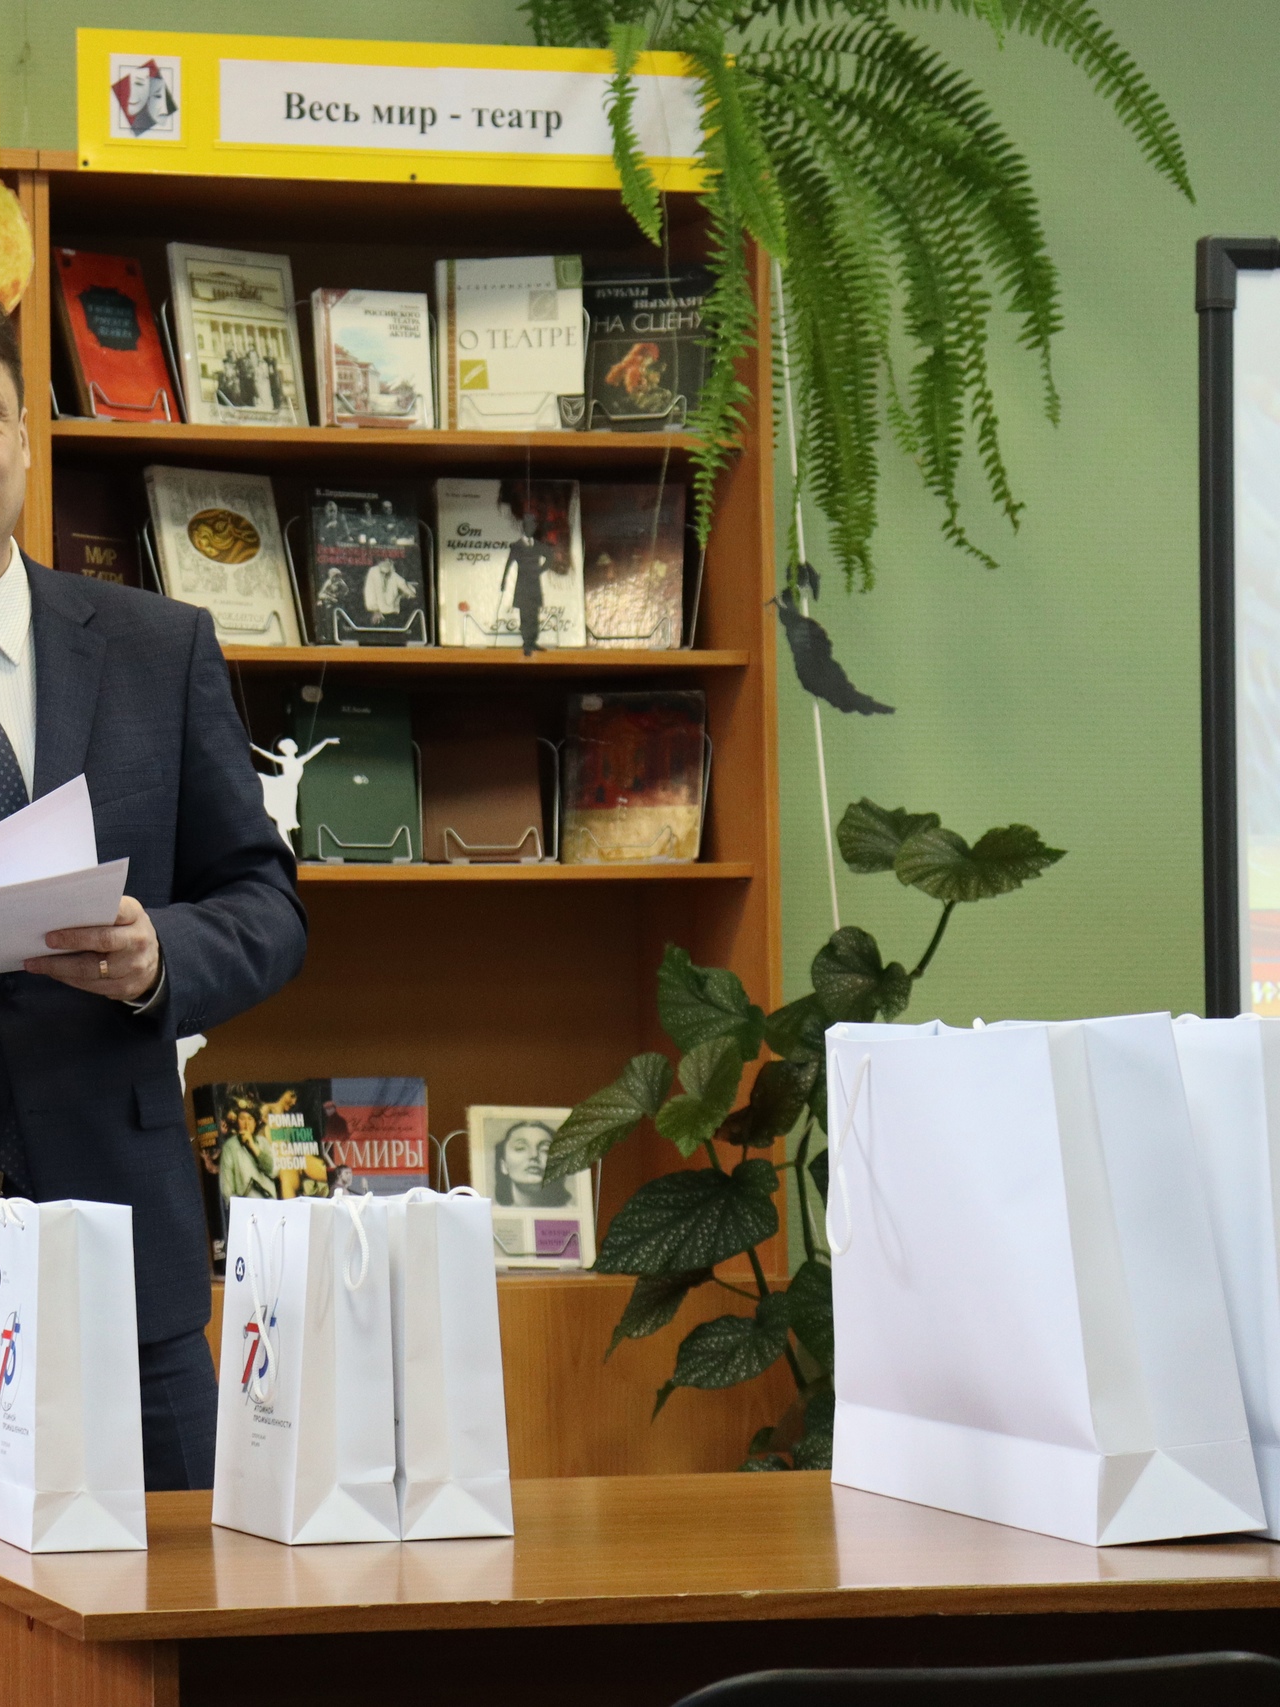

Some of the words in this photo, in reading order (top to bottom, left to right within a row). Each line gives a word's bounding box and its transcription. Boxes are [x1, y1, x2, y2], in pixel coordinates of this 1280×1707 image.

[284, 91, 360, 124] Весь
[371, 104, 438, 134] мир
[472, 105, 563, 138] театр
[593, 314, 626, 334] НА
[631, 310, 704, 334] СЦЕНУ
[458, 329, 479, 350] О
[487, 326, 577, 349] ТЕАТРЕ
[457, 522, 482, 537] От
[85, 545, 118, 566] МИР
[269, 1113, 305, 1127] РОМАН
[280, 1141, 319, 1155] САМИМ
[320, 1139, 424, 1169] КУМИРЫ
